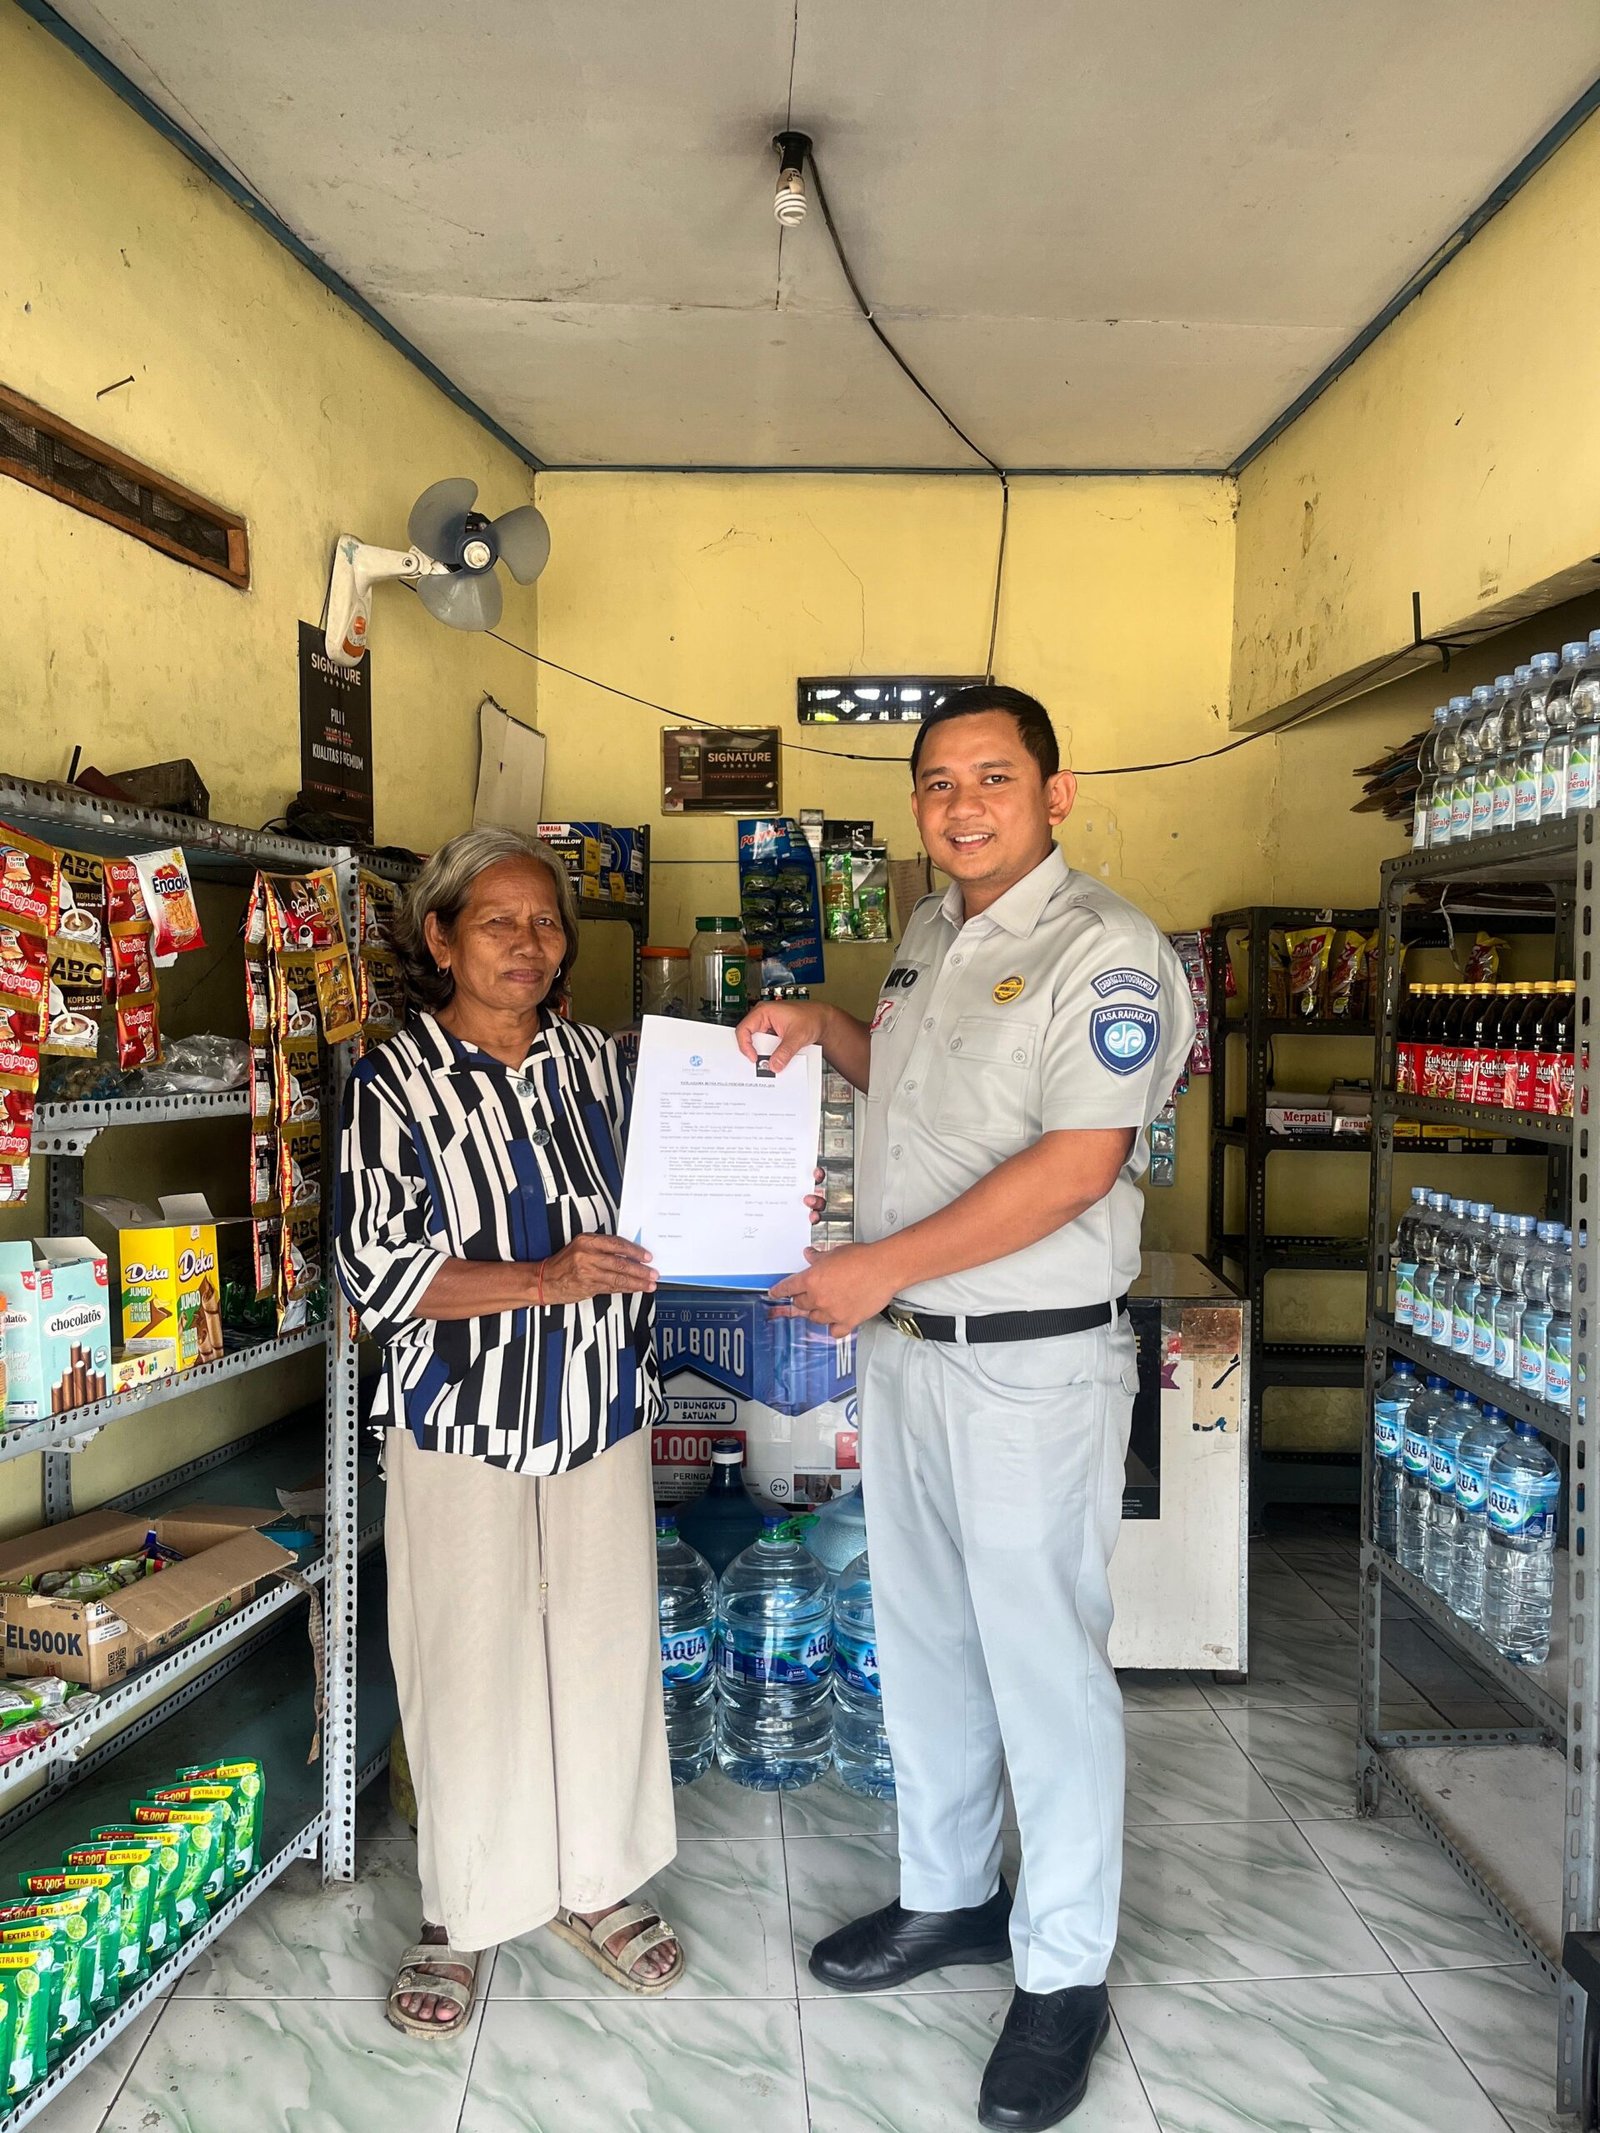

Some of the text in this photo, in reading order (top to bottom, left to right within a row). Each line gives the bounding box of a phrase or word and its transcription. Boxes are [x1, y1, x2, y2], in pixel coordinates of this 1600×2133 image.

[312, 743, 339, 764] KUALITAS
[707, 752, 772, 762] SIGNATURE
[61, 852, 103, 883] ABC
[152, 872, 189, 894] Enaak
[76, 891, 103, 901] KOPI SUS
[317, 893, 331, 902] TOP
[50, 956, 103, 985] ABC
[287, 966, 315, 985] ABC
[67, 995, 102, 1005] KOPI SUS
[1098, 1010, 1153, 1024] JASA RAHARJA
[288, 1050, 318, 1069] ABC
[1283, 1112, 1326, 1124] Merpati
[291, 1134, 320, 1153] ABC
[291, 1217, 319, 1236] ABC
[95, 1264, 107, 1276] 24
[125, 1263, 169, 1283] Deka
[178, 1248, 215, 1282] Deka
[24, 1276, 34, 1284] 24
[129, 1287, 152, 1297] JUMBO
[180, 1291, 201, 1311] JUMBO
[652, 1327, 745, 1377] RLBORO
[137, 1357, 158, 1376] Yupi
[673, 1401, 726, 1410] DIBUNGKUS
[682, 1411, 717, 1420] SATUAN
[1375, 1423, 1397, 1442] QUA
[1405, 1438, 1428, 1459] QUA
[1430, 1453, 1452, 1475] QUA
[673, 1472, 712, 1480] PERINGA
[1457, 1471, 1480, 1494] QUA
[773, 1484, 787, 1492] 21+
[1488, 1491, 1520, 1515] QUA
[6, 1623, 84, 1657] EL900K
[660, 1634, 708, 1662] AQUA
[219, 1767, 239, 1777] EXTRA
[194, 1788, 213, 1796] EXTRA
[172, 1813, 193, 1821] EXTRA
[109, 1853, 131, 1861] EXTRA
[68, 1877, 90, 1885] EXTRA
[98, 1878, 103, 1886] g
[7, 1929, 46, 1940] EXTRA 15 g
[16, 1956, 24, 1964] 15
[24, 1957, 30, 1965] g
